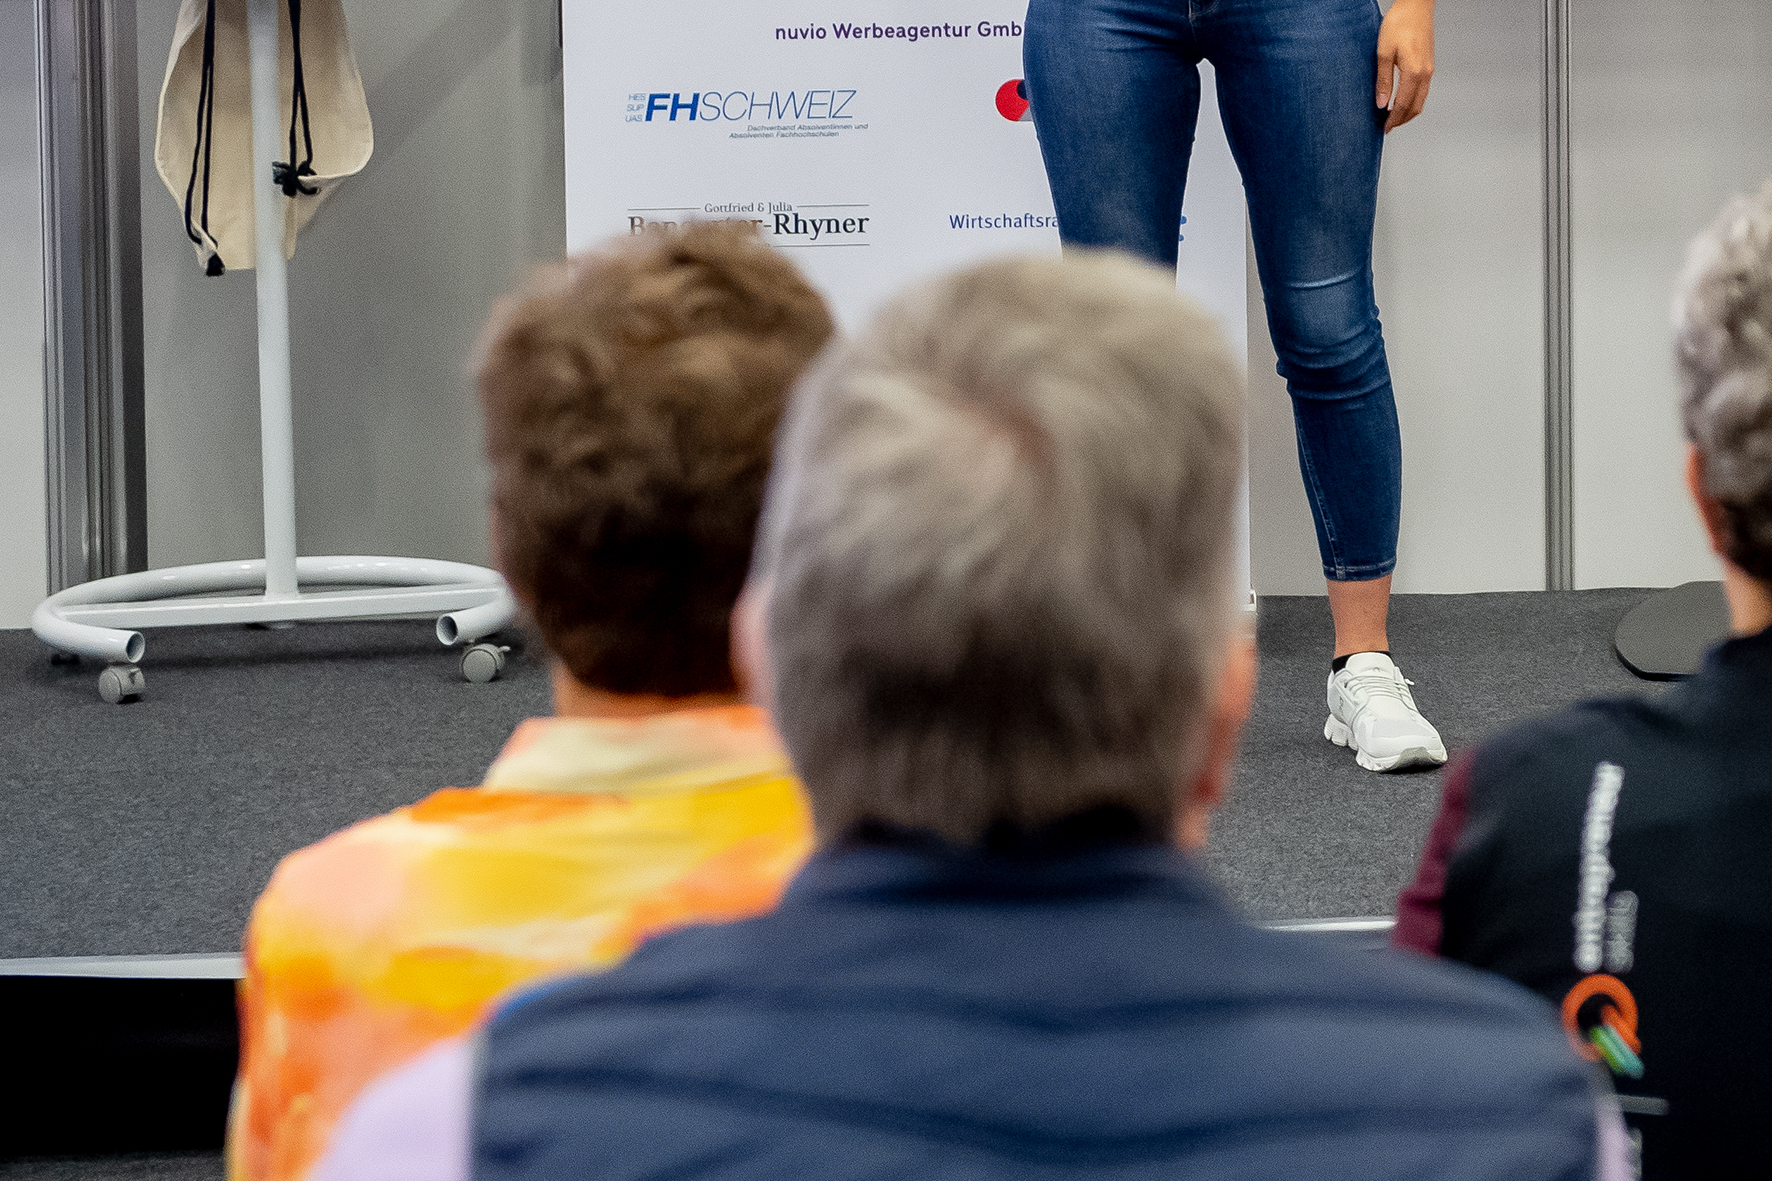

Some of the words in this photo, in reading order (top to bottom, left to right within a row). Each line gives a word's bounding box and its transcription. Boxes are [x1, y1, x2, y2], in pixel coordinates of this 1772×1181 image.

[775, 22, 827, 40] nuvio
[832, 22, 972, 43] Werbeagentur
[977, 20, 1023, 38] Gmb
[704, 202, 755, 213] Gottfried
[757, 202, 765, 212] &
[767, 201, 793, 215] Julia
[949, 212, 1059, 230] Wirtschaftsra
